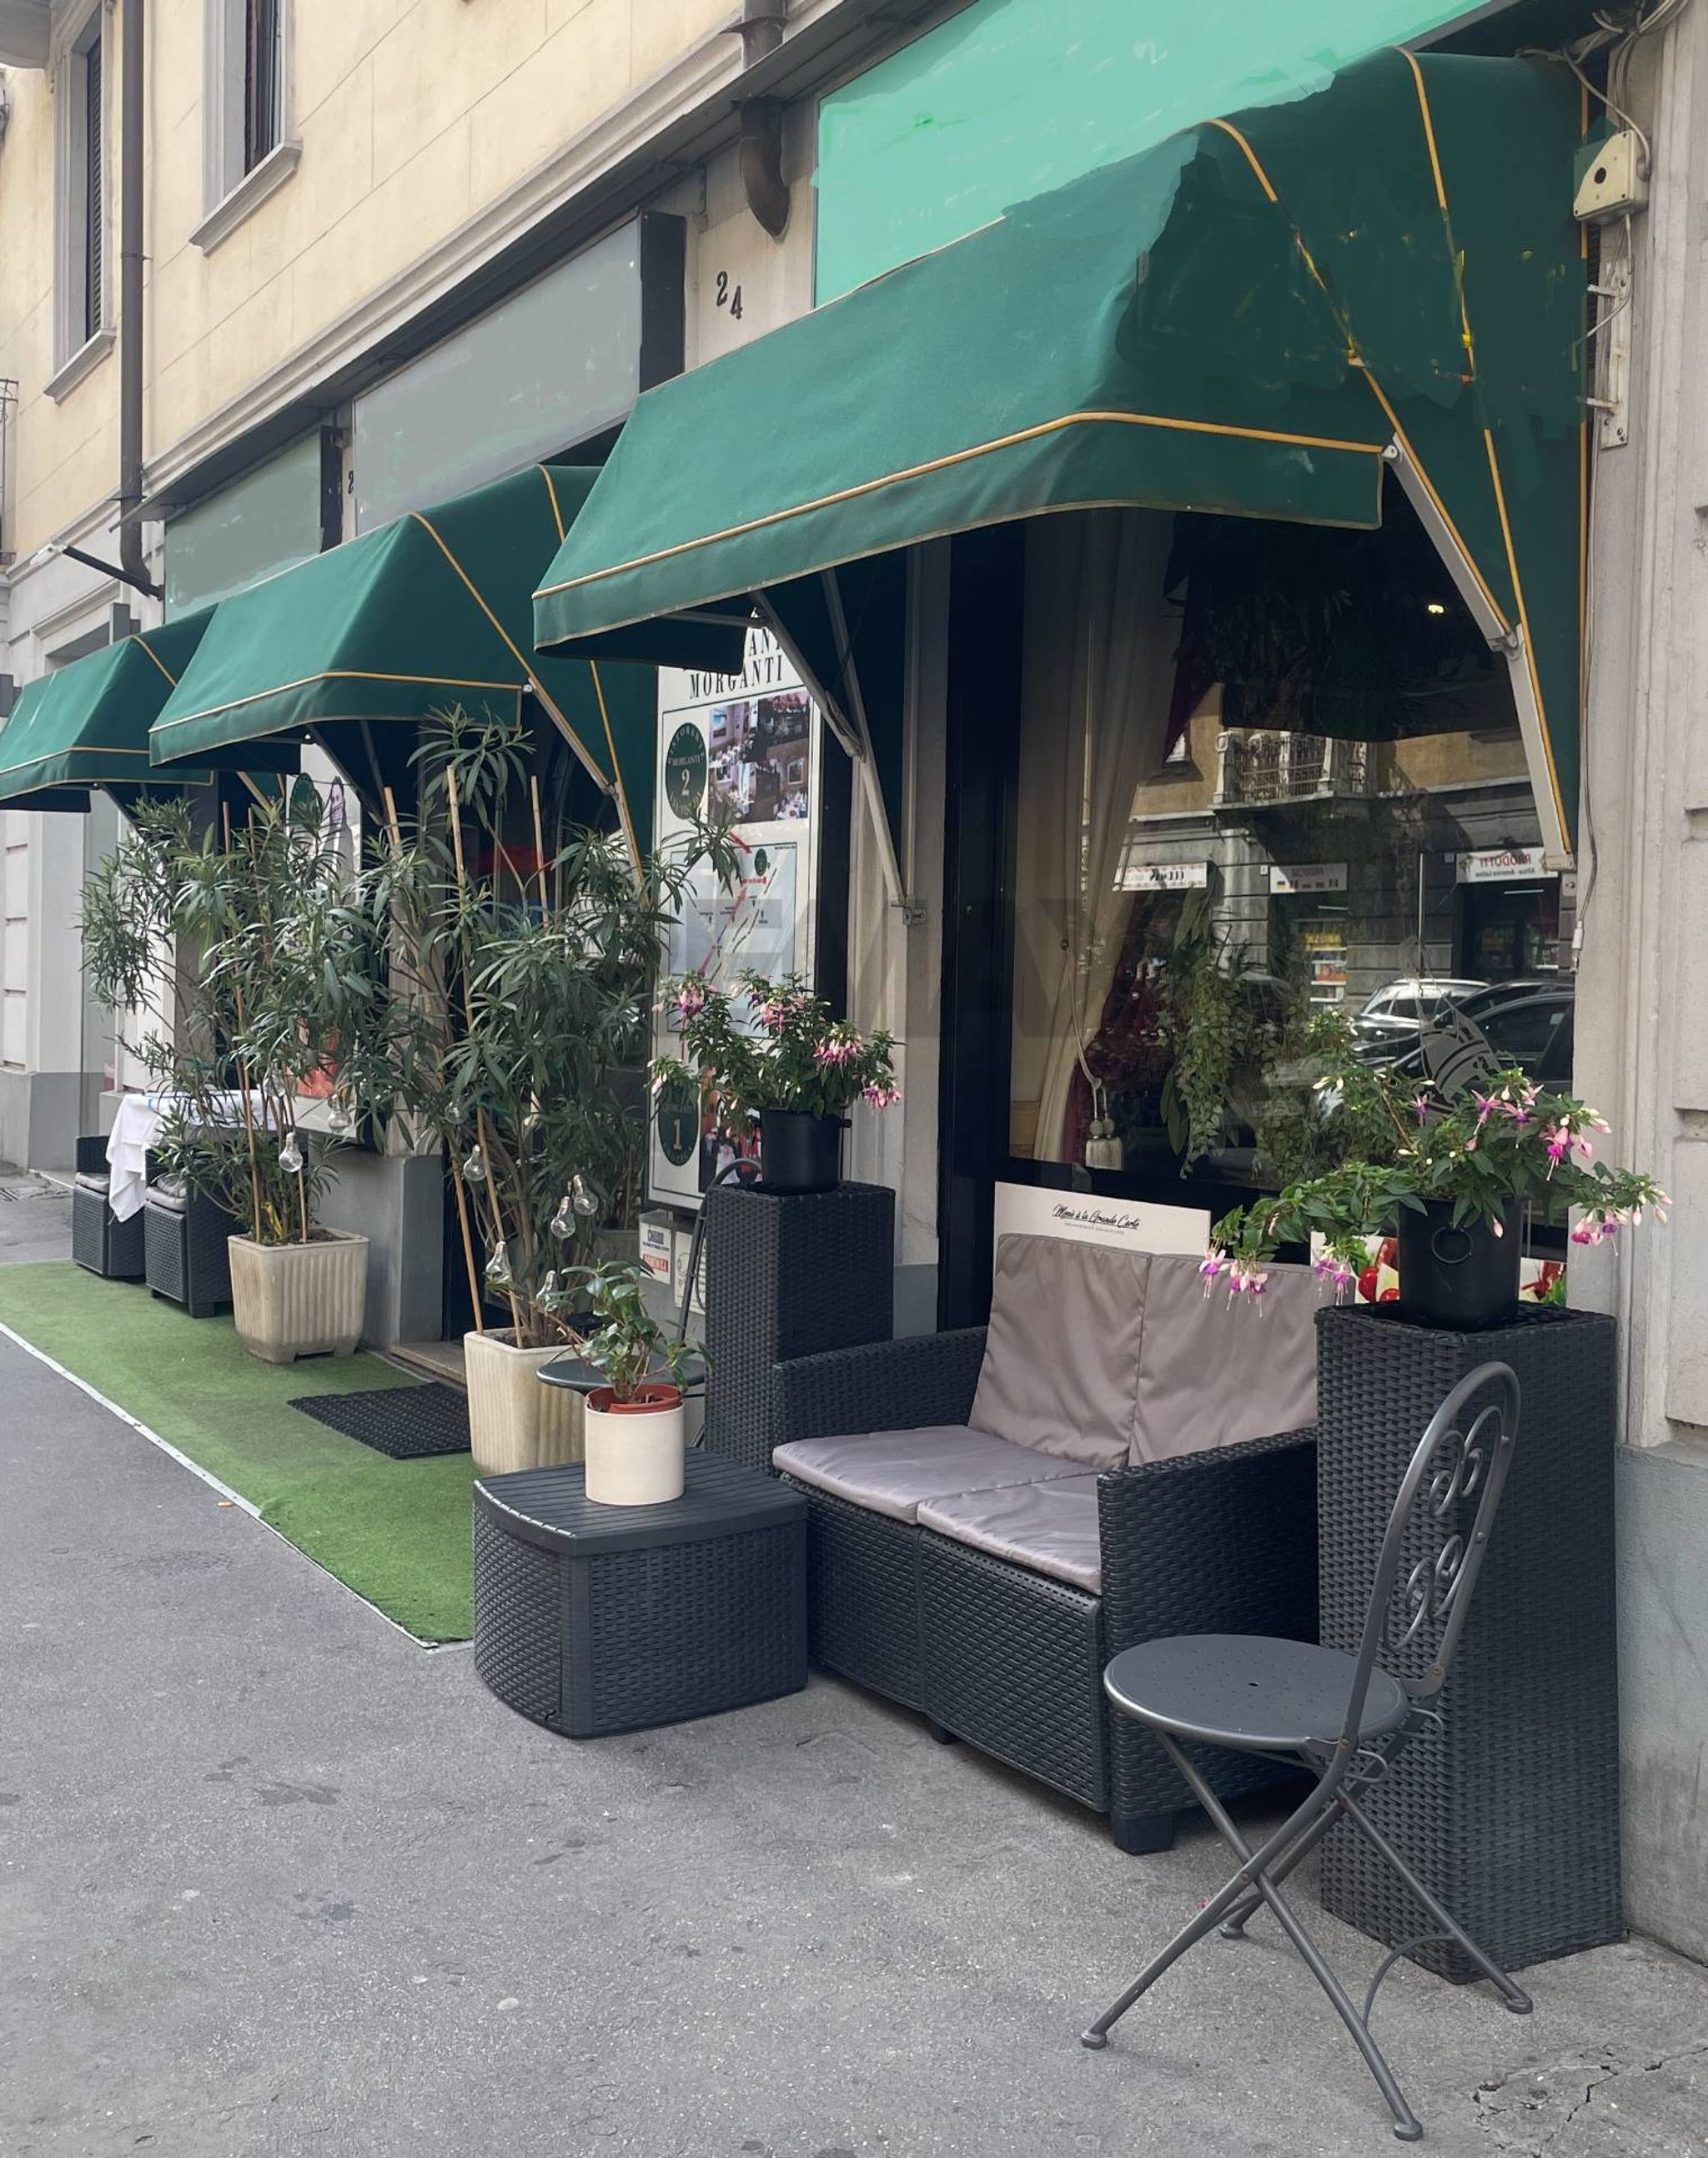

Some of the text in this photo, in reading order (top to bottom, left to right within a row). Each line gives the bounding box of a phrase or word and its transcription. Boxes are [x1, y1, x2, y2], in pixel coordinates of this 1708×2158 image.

[716, 270, 743, 319] 24
[690, 655, 782, 699] MORGANTI
[681, 768, 691, 796] 2
[673, 1118, 682, 1150] 1
